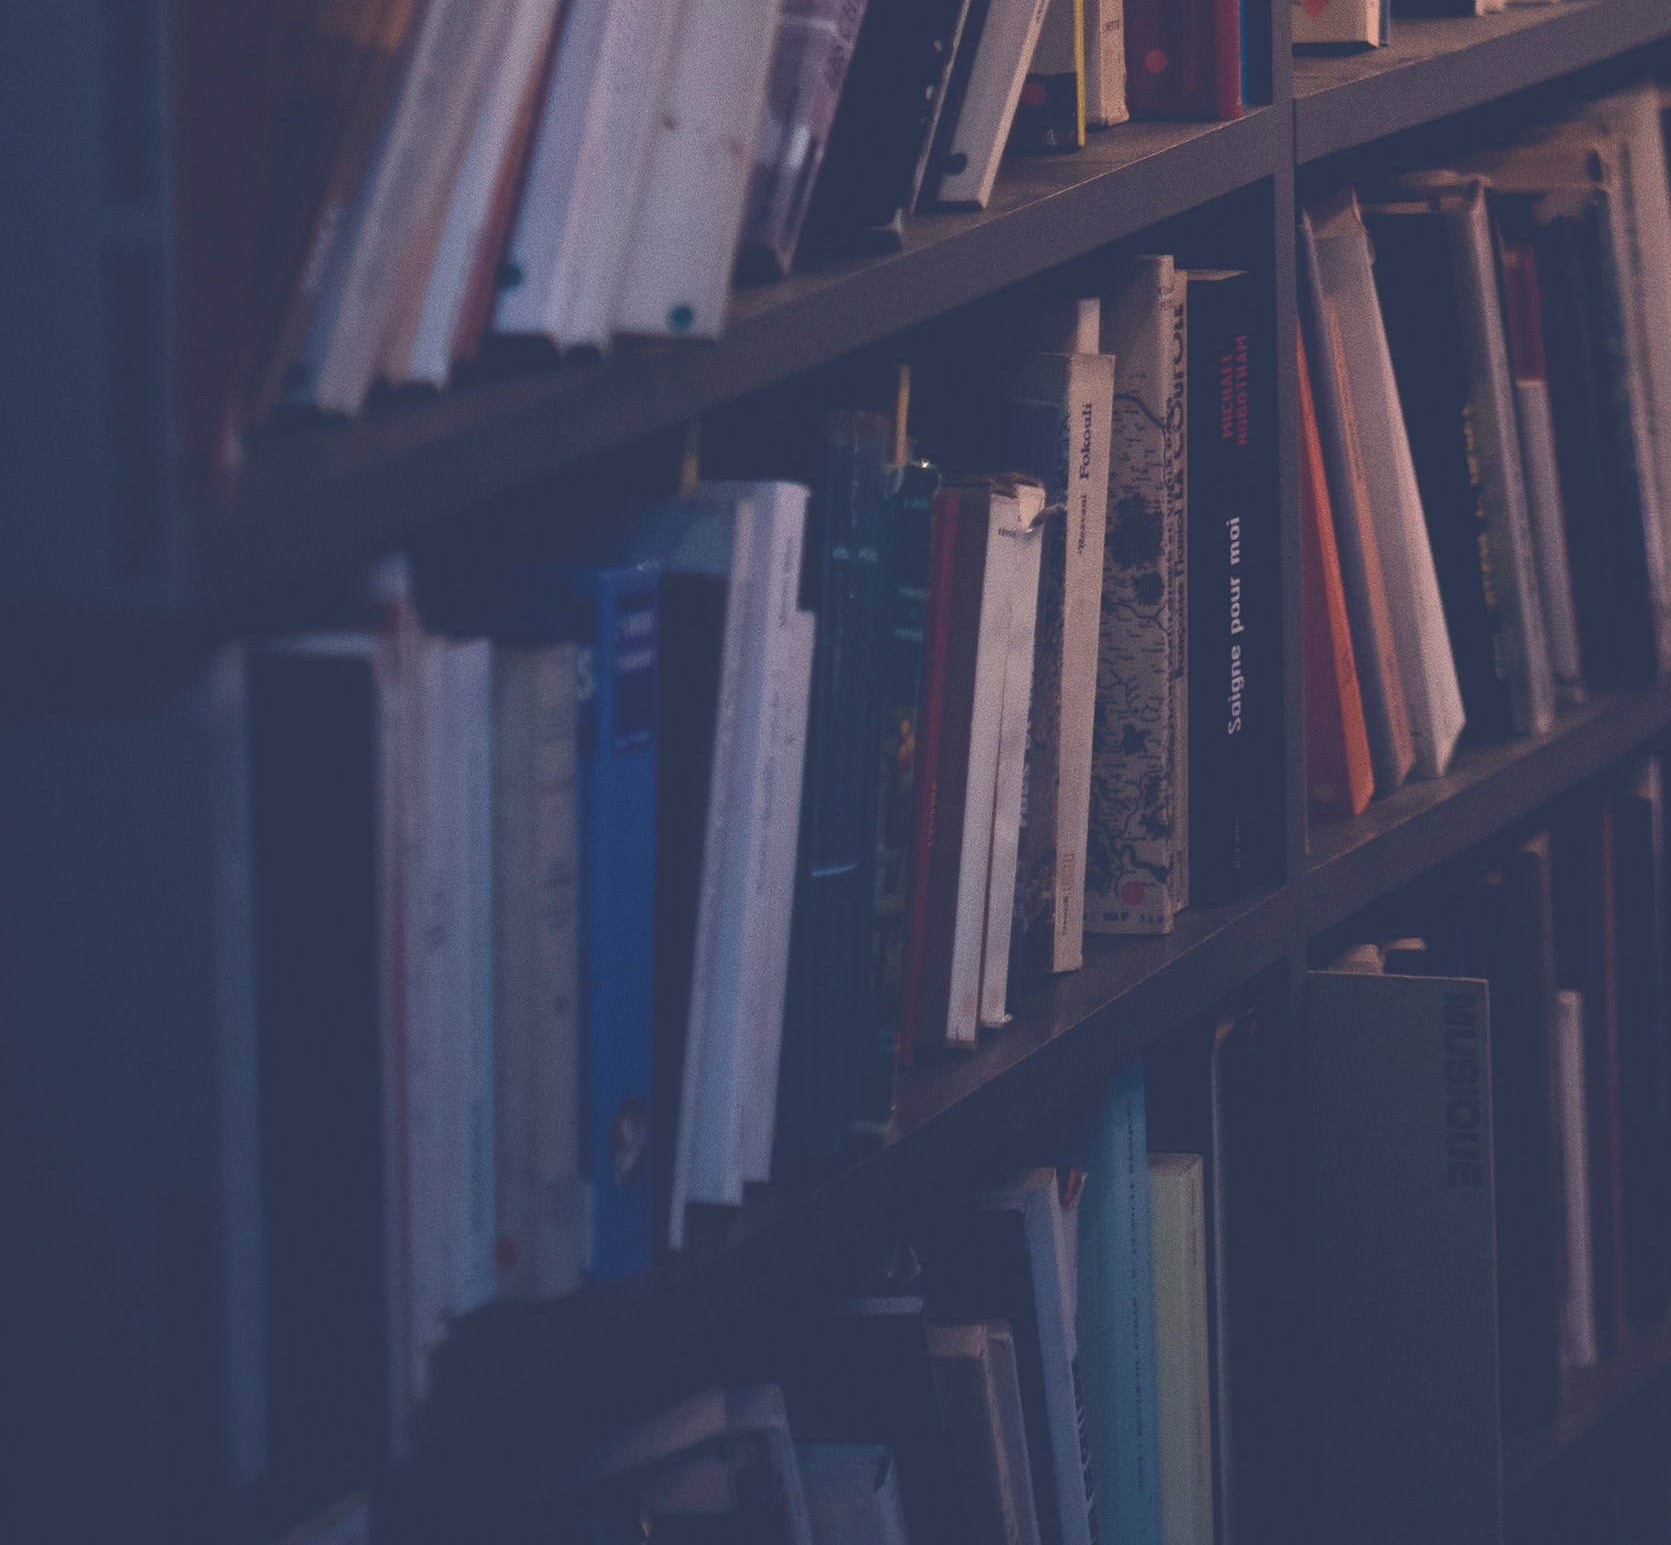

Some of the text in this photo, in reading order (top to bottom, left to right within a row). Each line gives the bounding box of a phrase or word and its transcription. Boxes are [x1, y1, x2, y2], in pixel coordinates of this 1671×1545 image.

[1078, 403, 1093, 479] Fokouli
[1221, 354, 1233, 438] MICHAEL
[1236, 335, 1248, 445] ROBOTHAM
[1225, 517, 1245, 734] Saigne pour moi
[1443, 993, 1483, 1190] MUSIQUE
